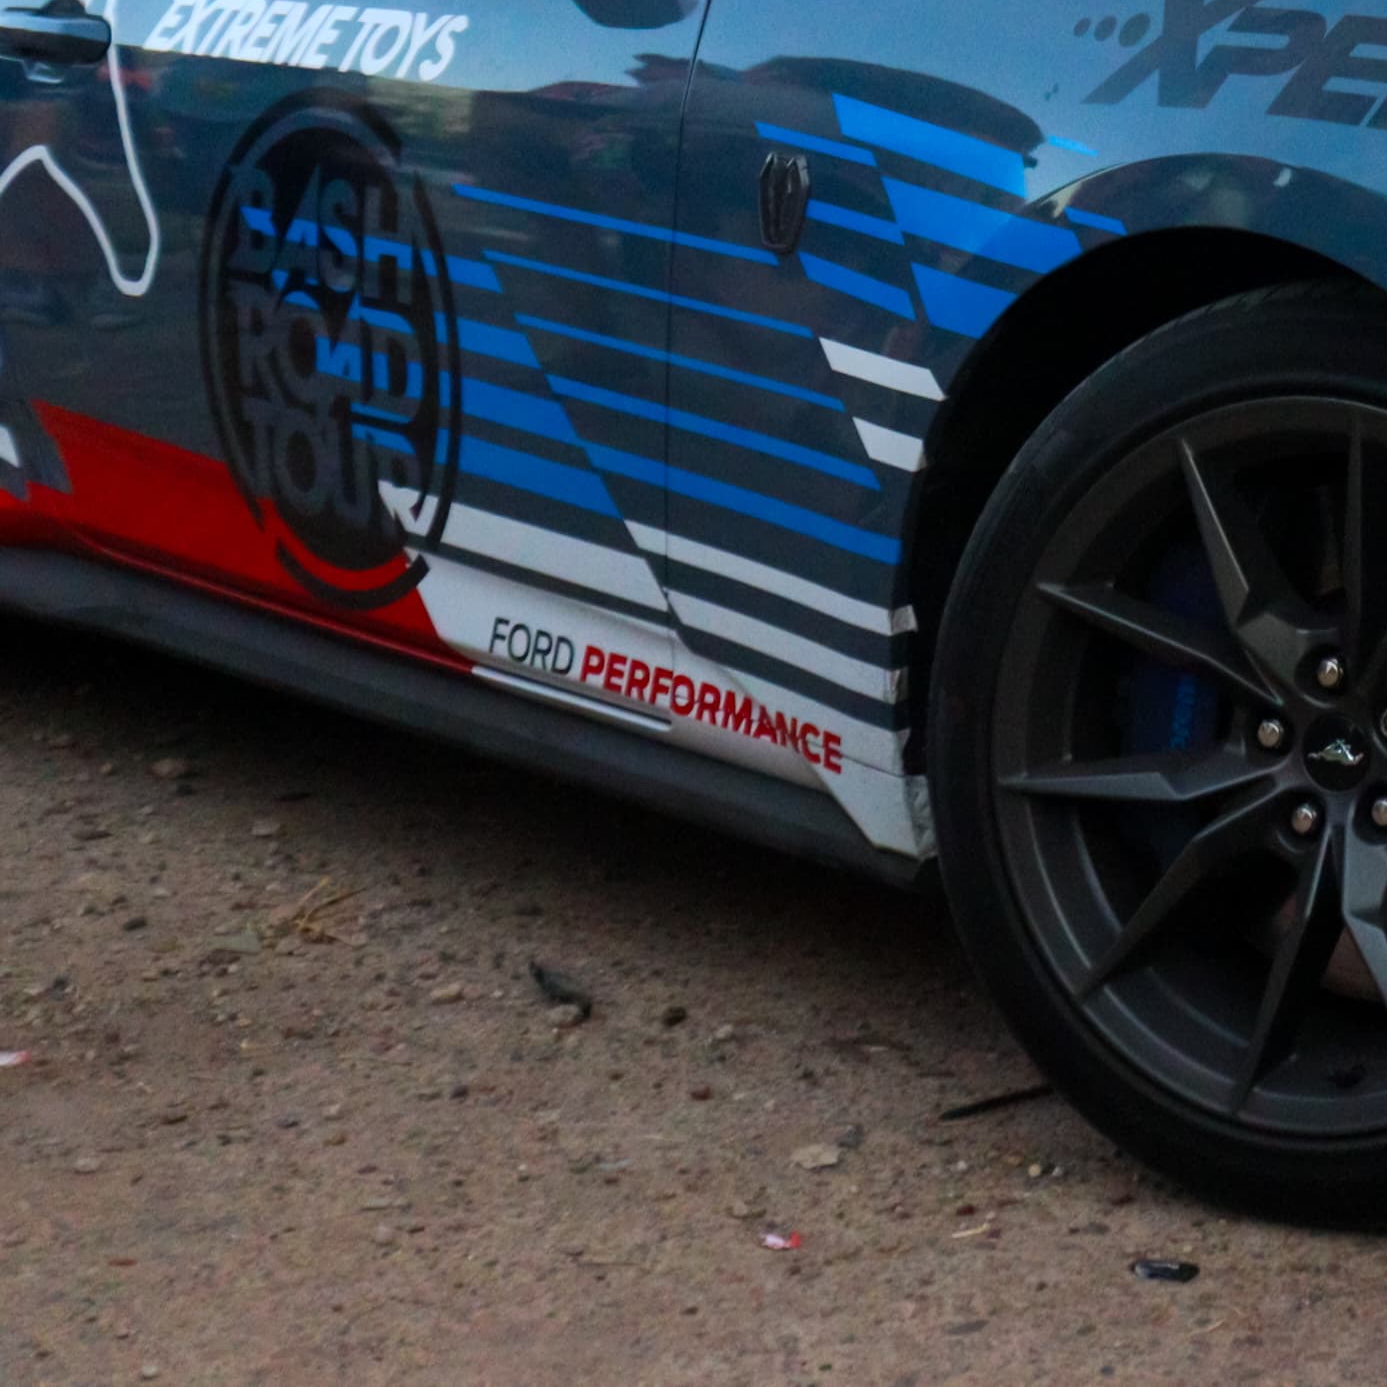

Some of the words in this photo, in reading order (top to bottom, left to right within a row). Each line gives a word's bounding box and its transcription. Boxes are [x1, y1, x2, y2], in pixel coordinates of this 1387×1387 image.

[338, 1, 469, 81] TOYS
[225, 161, 417, 309] BASH
[225, 275, 427, 425] ROAD
[488, 616, 576, 676] FORD
[579, 645, 844, 776] PERFORMANCE
